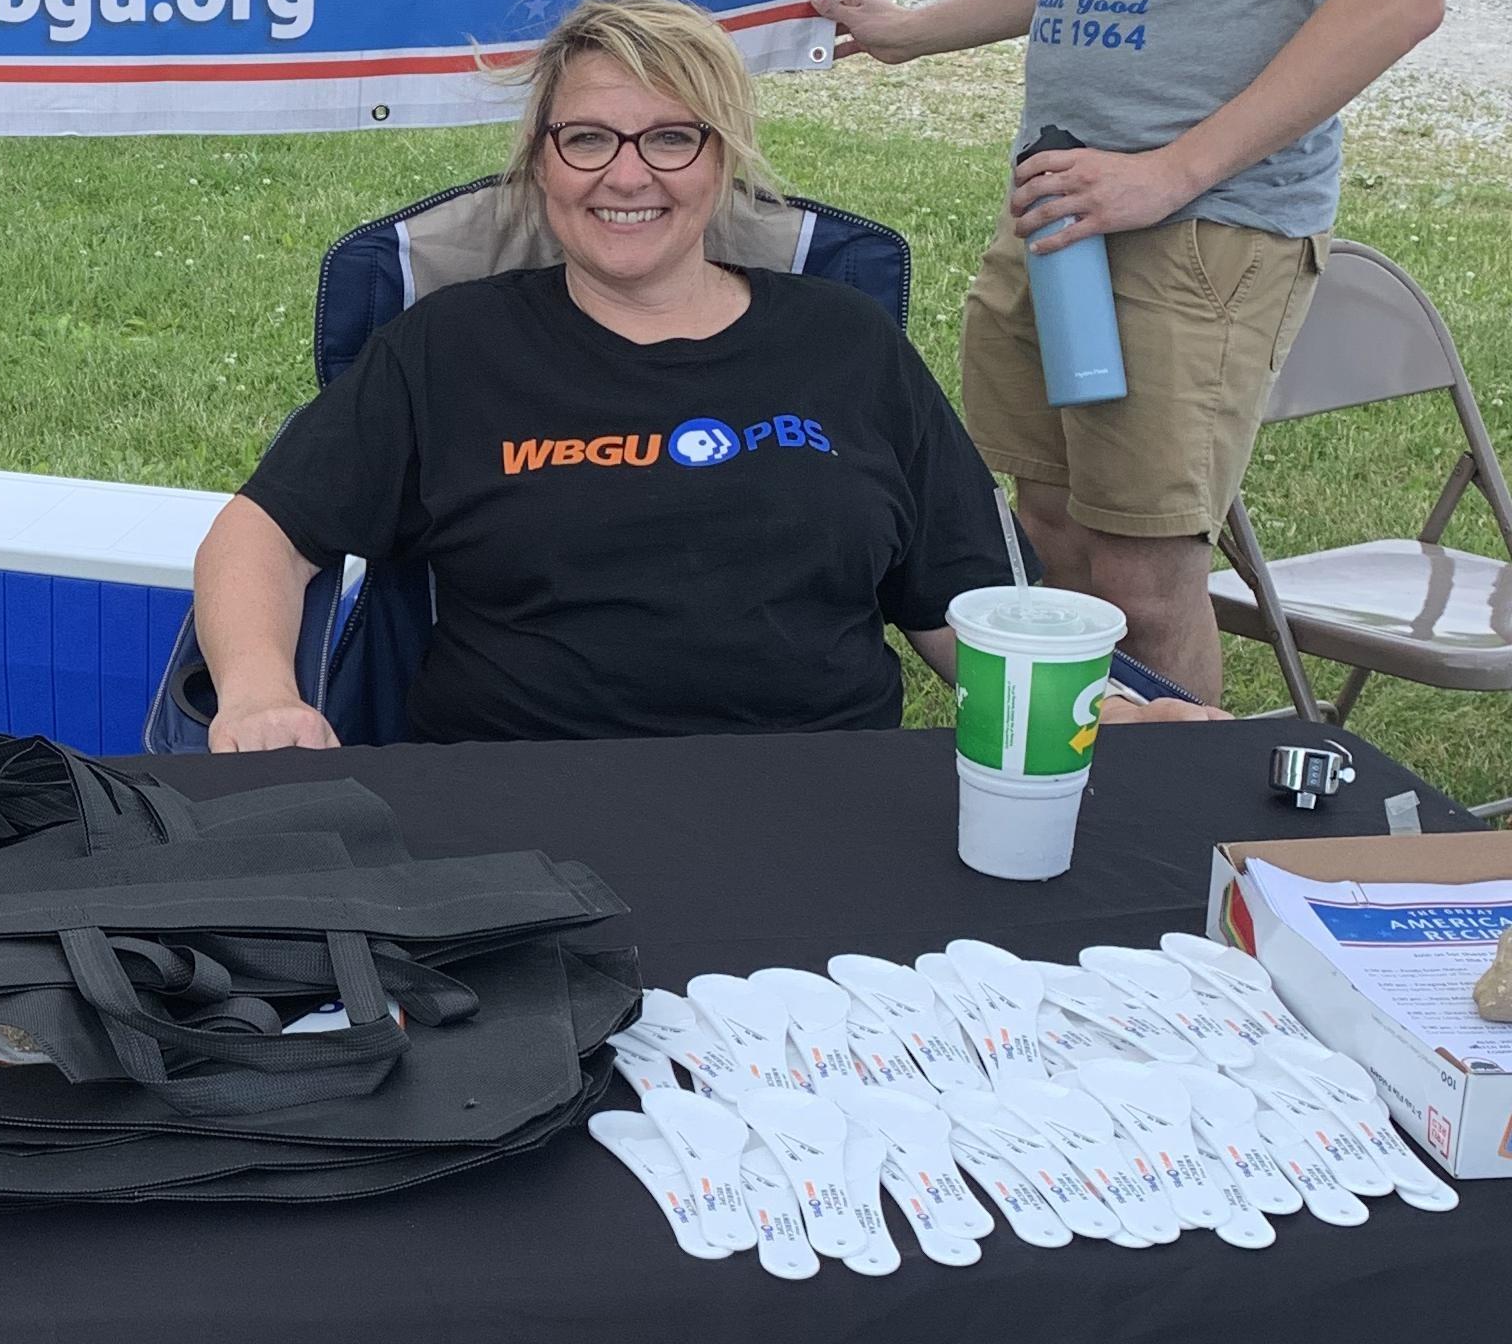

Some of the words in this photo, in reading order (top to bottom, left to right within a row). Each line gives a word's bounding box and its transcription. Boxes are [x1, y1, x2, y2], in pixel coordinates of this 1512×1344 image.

[1071, 19, 1146, 50] 1964
[502, 433, 663, 475] WBGU
[743, 413, 832, 452] PBS
[1391, 916, 1512, 930] AMERICA
[1423, 929, 1503, 941] RECIP
[1440, 1071, 1457, 1090] 100
